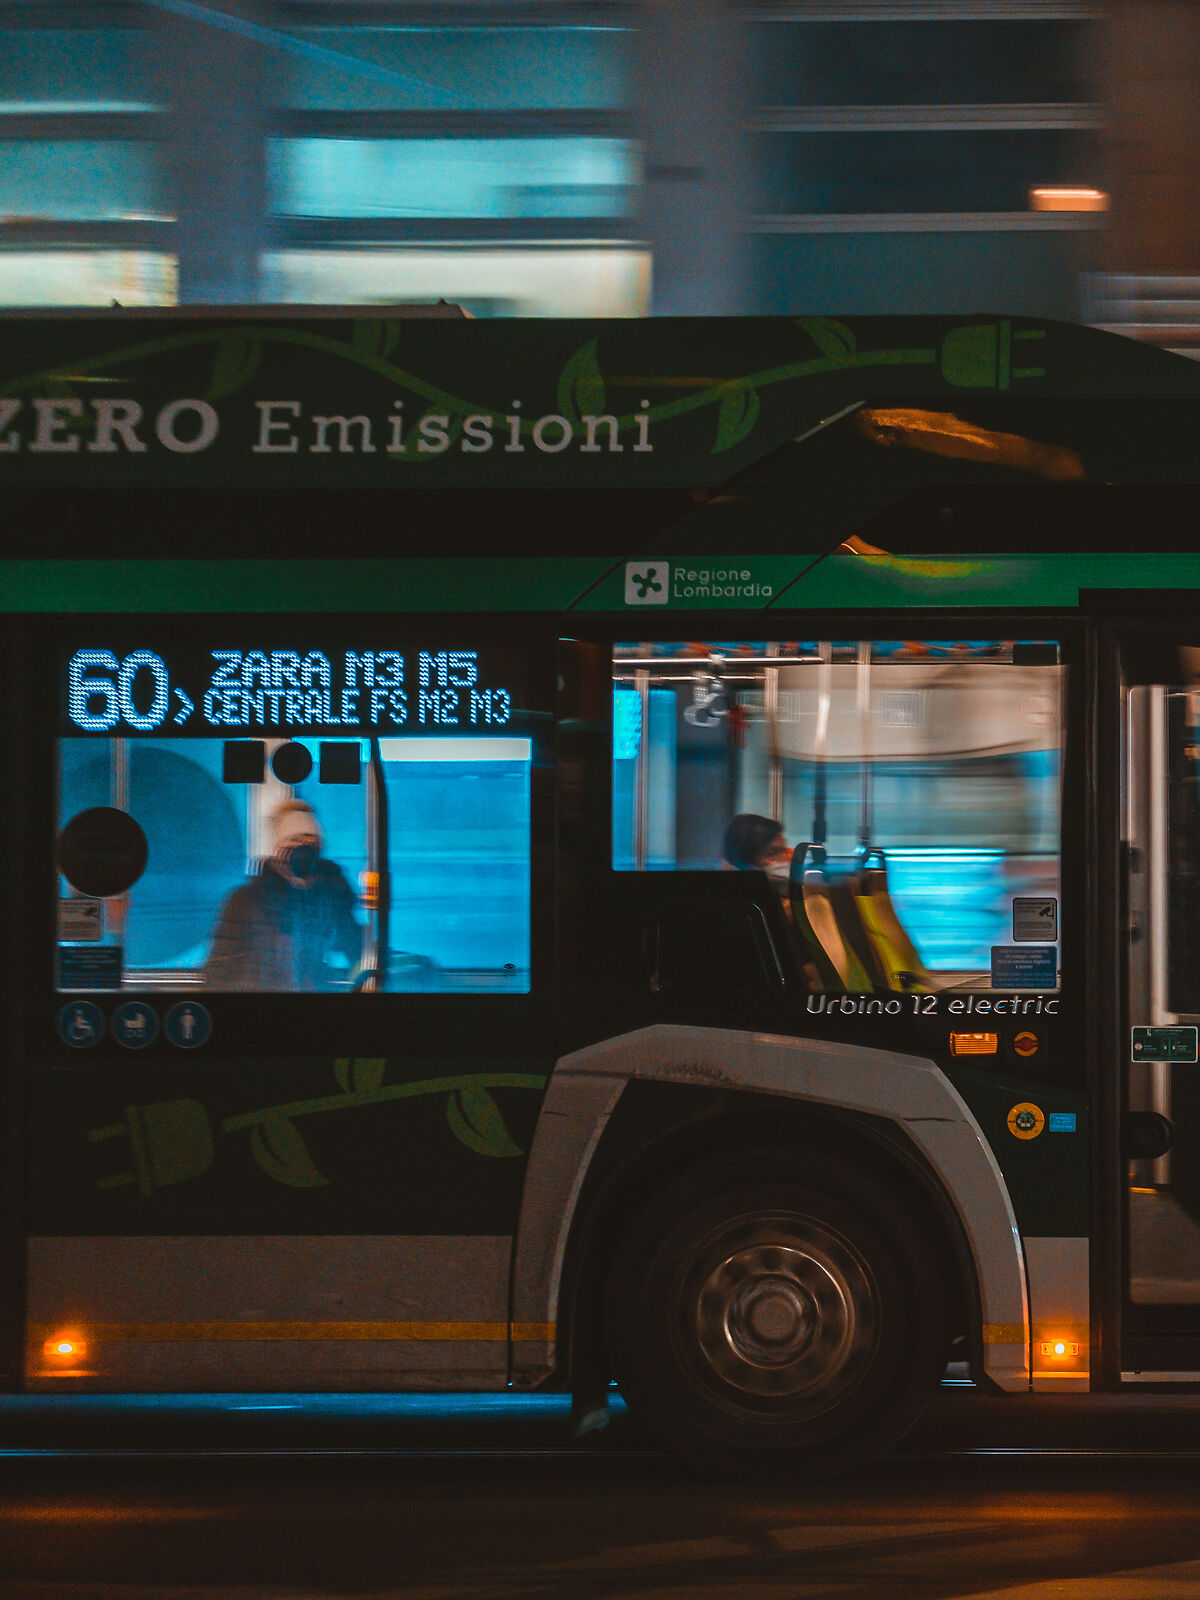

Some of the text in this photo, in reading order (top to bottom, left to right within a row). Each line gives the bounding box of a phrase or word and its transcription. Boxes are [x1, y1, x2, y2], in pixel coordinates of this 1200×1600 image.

[251, 399, 654, 453] Emissioni
[673, 567, 751, 584] Regione
[673, 584, 773, 598] Lombardia
[210, 650, 479, 688] ZARA M3 M5
[68, 648, 170, 732] 60
[203, 687, 512, 726] CENTRALE FS M2 M3
[805, 995, 1061, 1016] Urbino 12 electric
